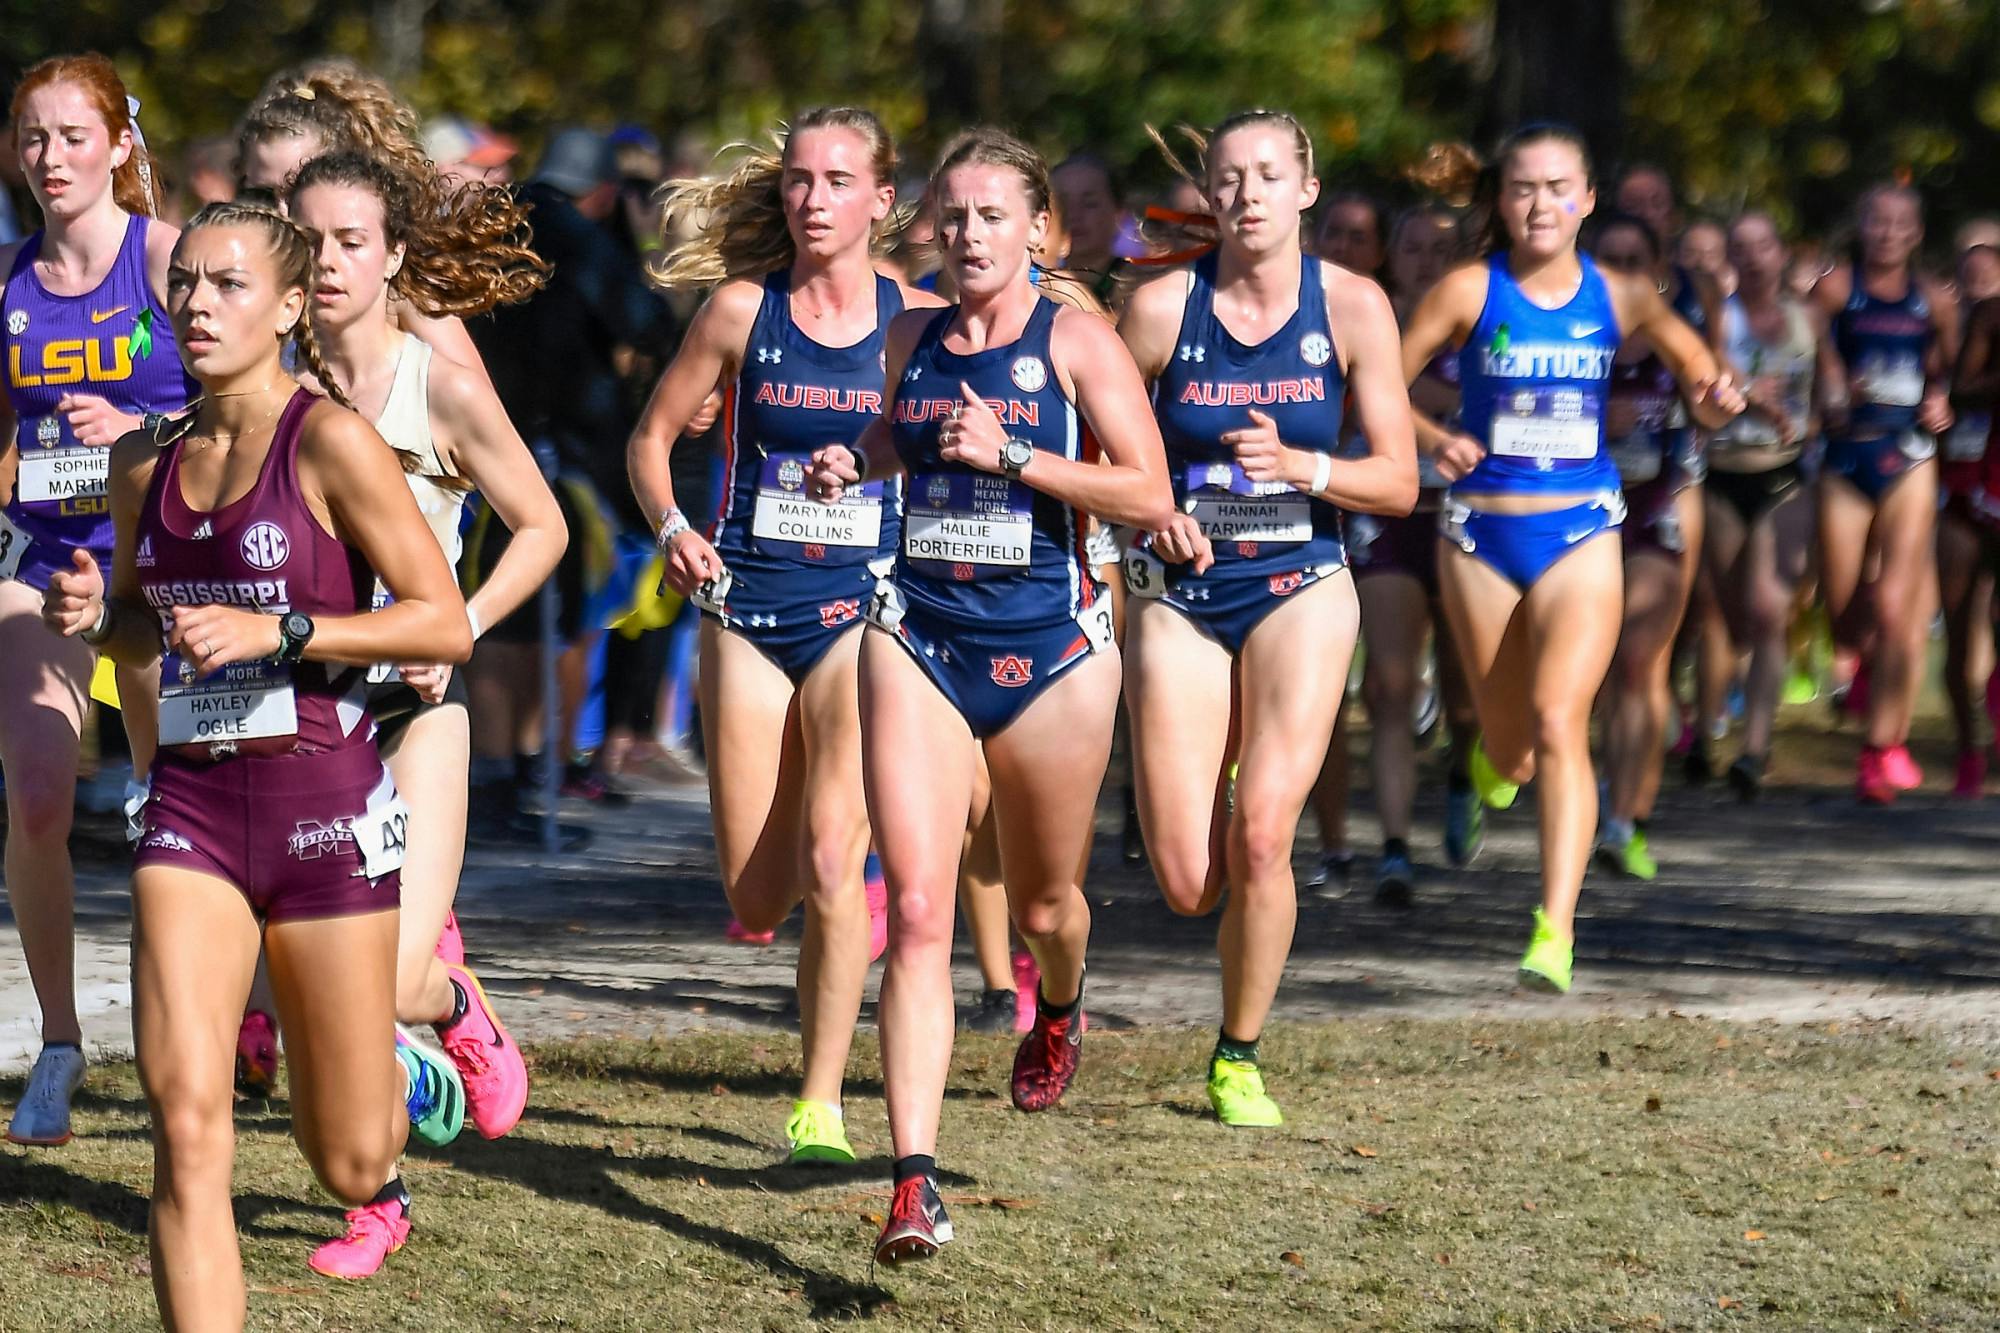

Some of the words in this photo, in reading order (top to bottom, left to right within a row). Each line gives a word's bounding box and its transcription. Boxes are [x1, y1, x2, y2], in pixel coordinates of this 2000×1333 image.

[8, 336, 132, 387] LSU
[1482, 345, 1616, 379] KENTUCKY
[755, 382, 882, 415] AUBUR
[1180, 376, 1326, 406] AUBURN
[892, 400, 1040, 426] AUBRN
[54, 458, 108, 474] SOPHIE
[984, 479, 1009, 490] JUST
[974, 489, 1009, 501] MEANS
[779, 503, 821, 518] MARY
[826, 508, 857, 521] MAC
[1218, 505, 1278, 517] HANNAH
[778, 521, 854, 541] COLLINS
[940, 522, 992, 538] HALLIE
[1199, 522, 1295, 537] TARWATER
[243, 524, 286, 568] SEC
[909, 538, 1025, 561] PORTERFIELD
[142, 579, 289, 608] MISSISSIPPI
[191, 695, 251, 714] HAYLEY
[196, 717, 248, 737] OGLE
